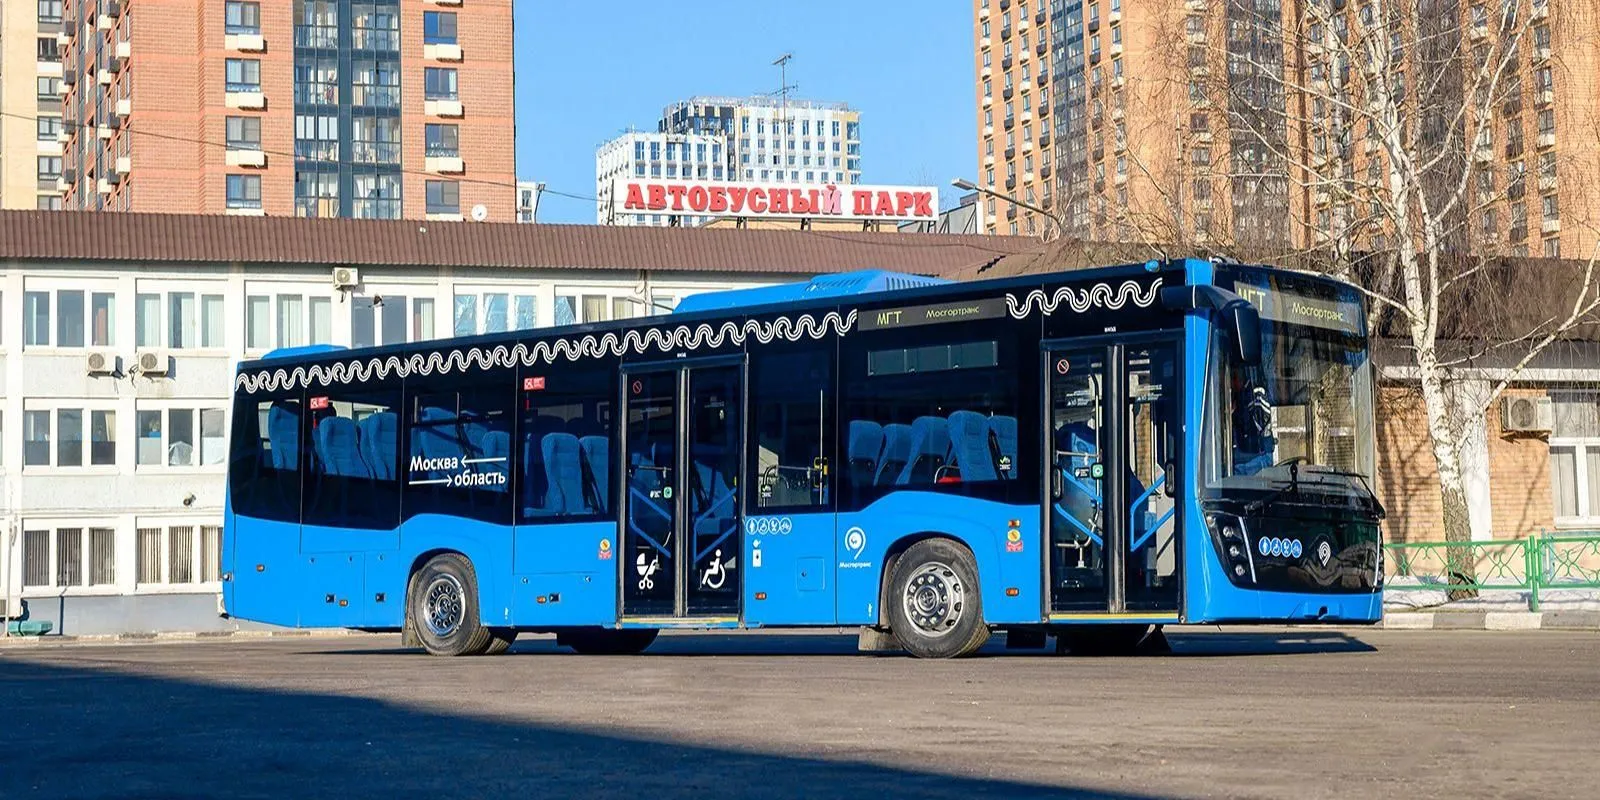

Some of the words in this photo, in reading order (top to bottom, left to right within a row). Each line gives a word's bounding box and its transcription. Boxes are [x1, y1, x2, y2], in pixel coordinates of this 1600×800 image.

[624, 183, 843, 215] АВТОБУСНЫЙ
[852, 190, 934, 217] ПАРК
[877, 311, 902, 325] МГТ
[926, 306, 980, 318] Мосгортранс
[1292, 302, 1344, 321] Мосгортранс
[409, 455, 458, 472] Москва
[454, 469, 506, 487] область
